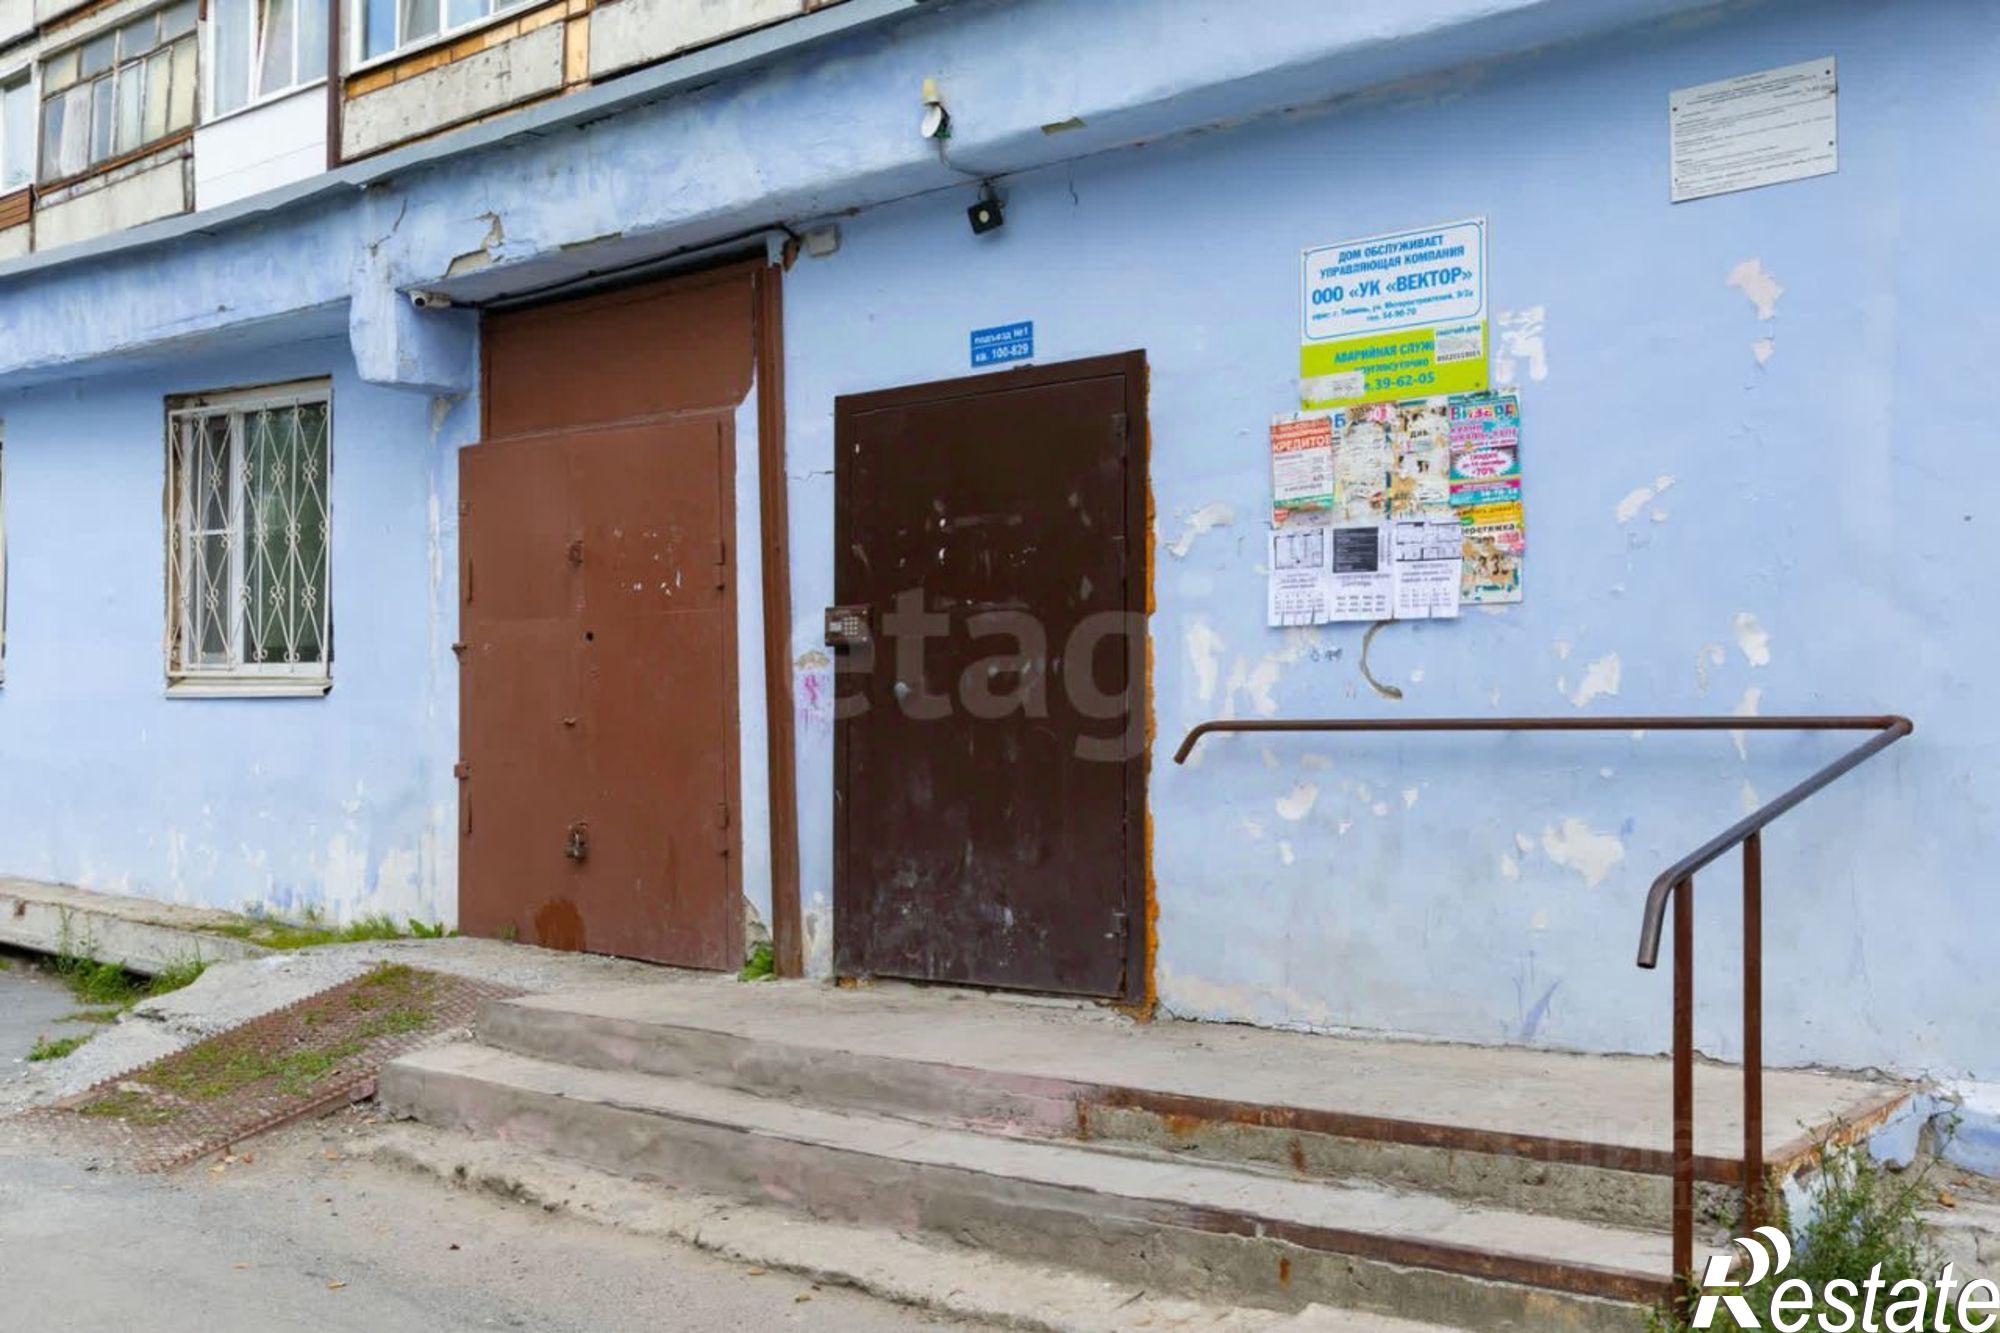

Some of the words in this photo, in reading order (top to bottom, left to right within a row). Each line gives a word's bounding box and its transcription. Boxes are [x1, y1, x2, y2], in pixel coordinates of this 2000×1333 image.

[1320, 255, 1401, 279] УПРАВЛЯЮЩАЯ
[1404, 245, 1465, 266] КОМПАНИЯ
[1338, 249, 1361, 264] ДОМ
[1364, 235, 1444, 257] ОБСЛУЖИВАЕТ
[1312, 286, 1344, 305] ООО
[1349, 279, 1380, 299] «УК
[1385, 266, 1473, 292] «ВЕКТОР»
[1334, 345, 1397, 363] АВАРИЙНАЯ
